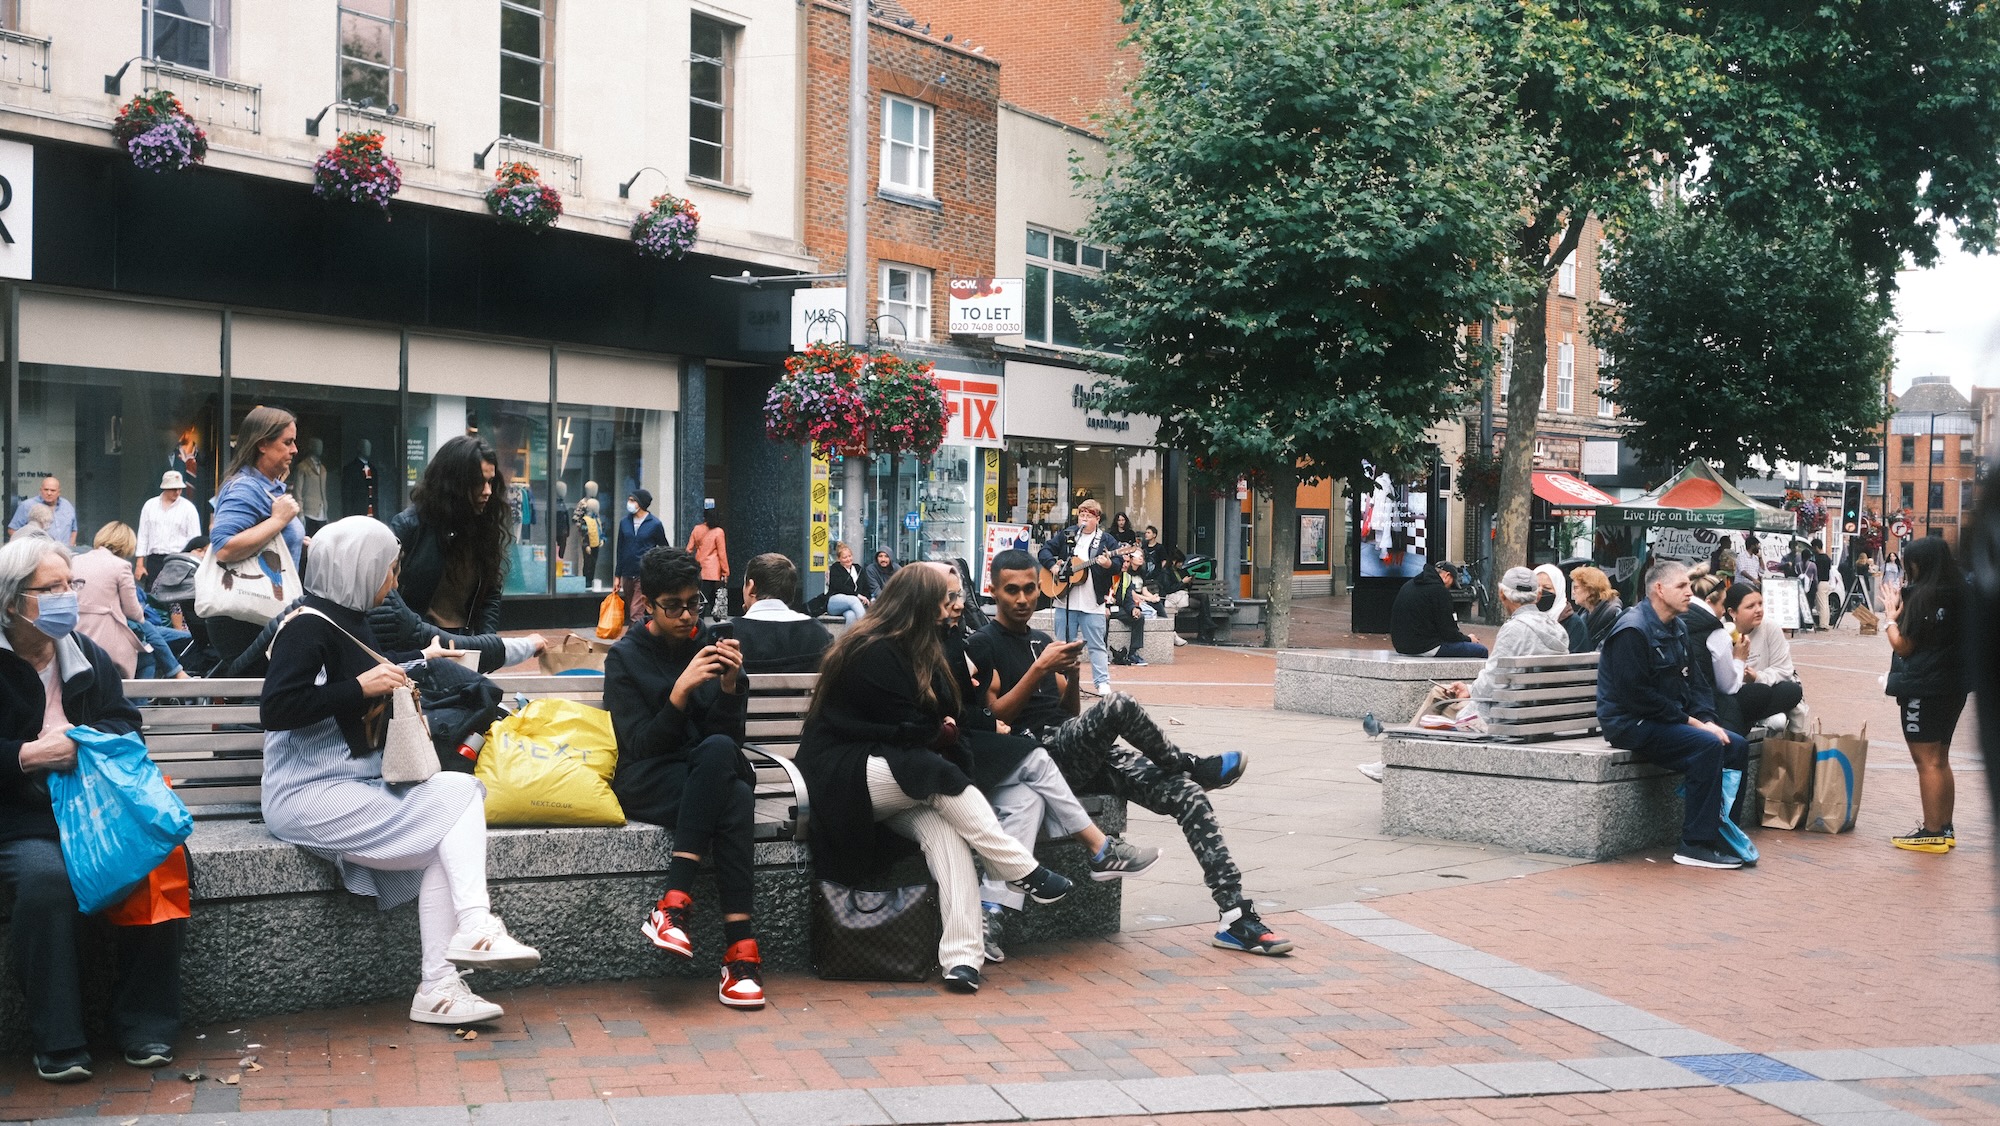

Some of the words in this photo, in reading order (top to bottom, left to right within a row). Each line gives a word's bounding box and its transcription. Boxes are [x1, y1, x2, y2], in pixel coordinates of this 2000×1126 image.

[804, 308, 837, 323] M&S
[961, 307, 981, 320] TO
[986, 307, 1011, 320] LET
[951, 322, 969, 331] 020
[972, 322, 993, 331] 7408
[996, 322, 1020, 331] 0030
[938, 378, 999, 440] FIX
[1623, 509, 1645, 521] Live
[1648, 509, 1667, 524] life
[1668, 512, 1682, 521] on
[1685, 510, 1702, 522] the
[1706, 513, 1725, 525] veg
[1669, 530, 1693, 543] Live
[1667, 542, 1684, 557] life
[1692, 545, 1711, 559] veg
[503, 732, 592, 763] NEXT
[530, 799, 574, 809] NEXT.CO.UK
